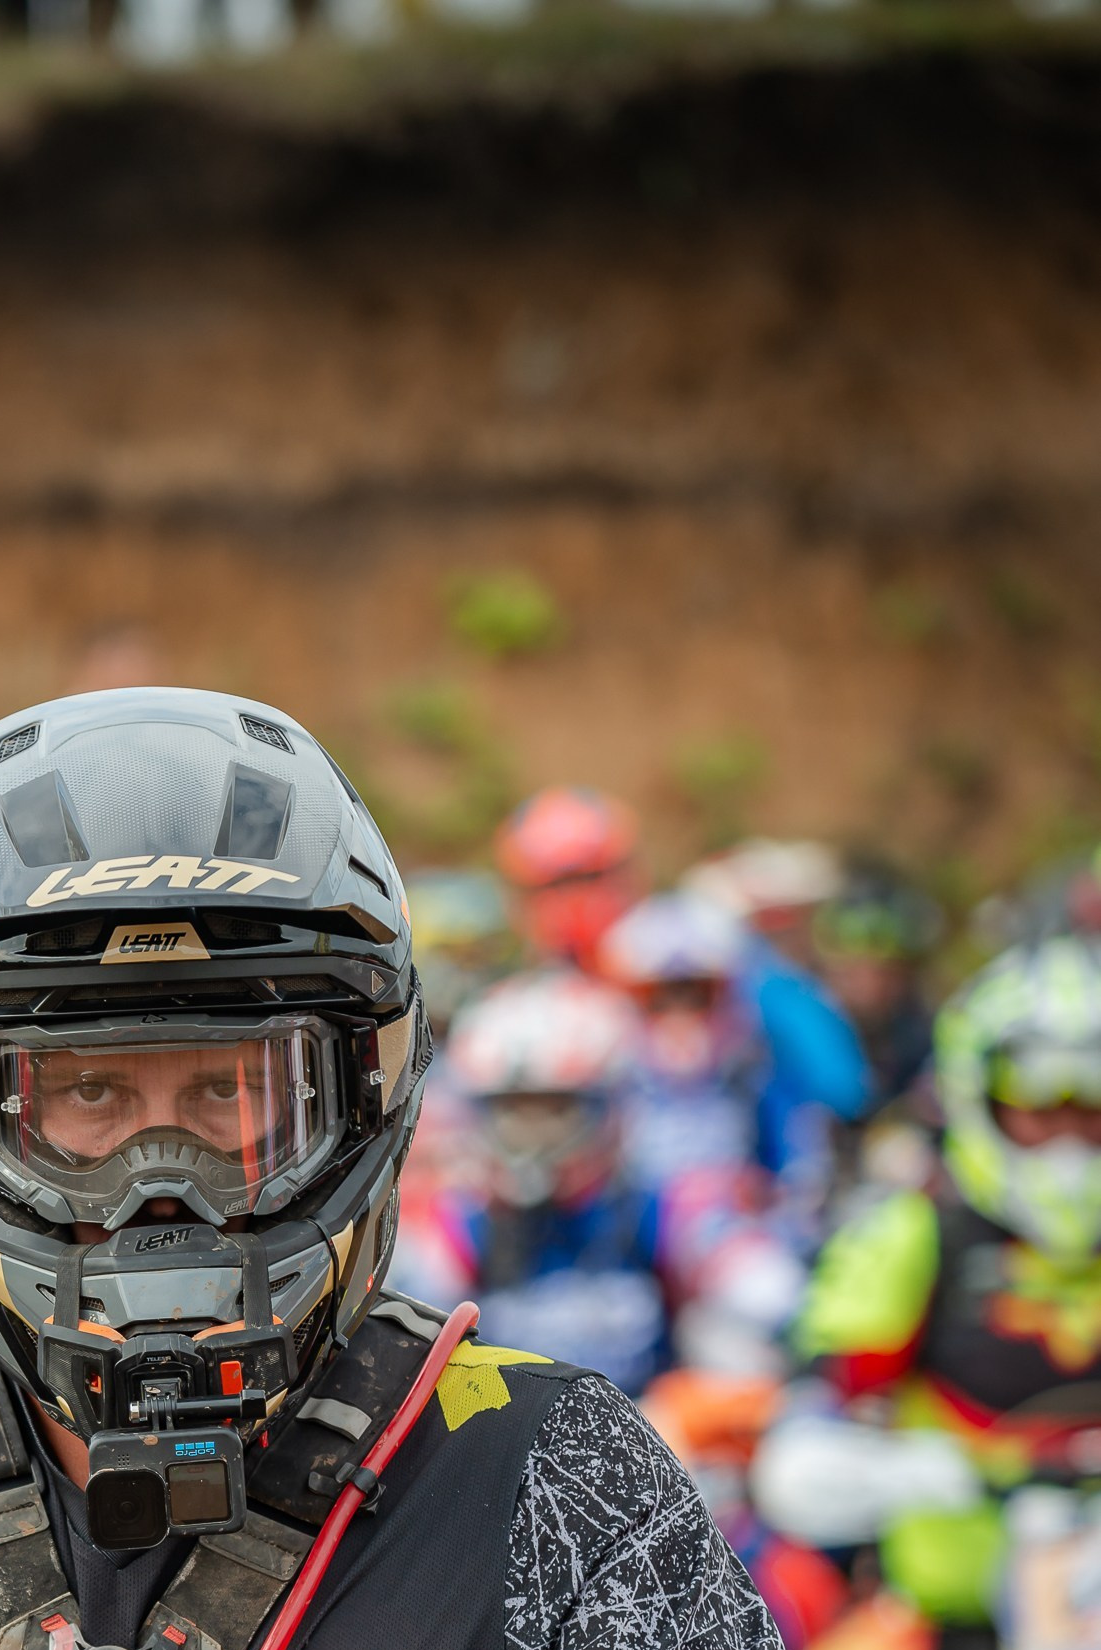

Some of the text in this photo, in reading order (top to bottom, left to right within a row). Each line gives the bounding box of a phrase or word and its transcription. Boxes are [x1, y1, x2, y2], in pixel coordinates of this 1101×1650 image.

[26, 855, 301, 907] LEATT
[118, 931, 186, 954] LEATT
[134, 1226, 197, 1254] LEATT
[175, 1448, 216, 1457] GoPro
